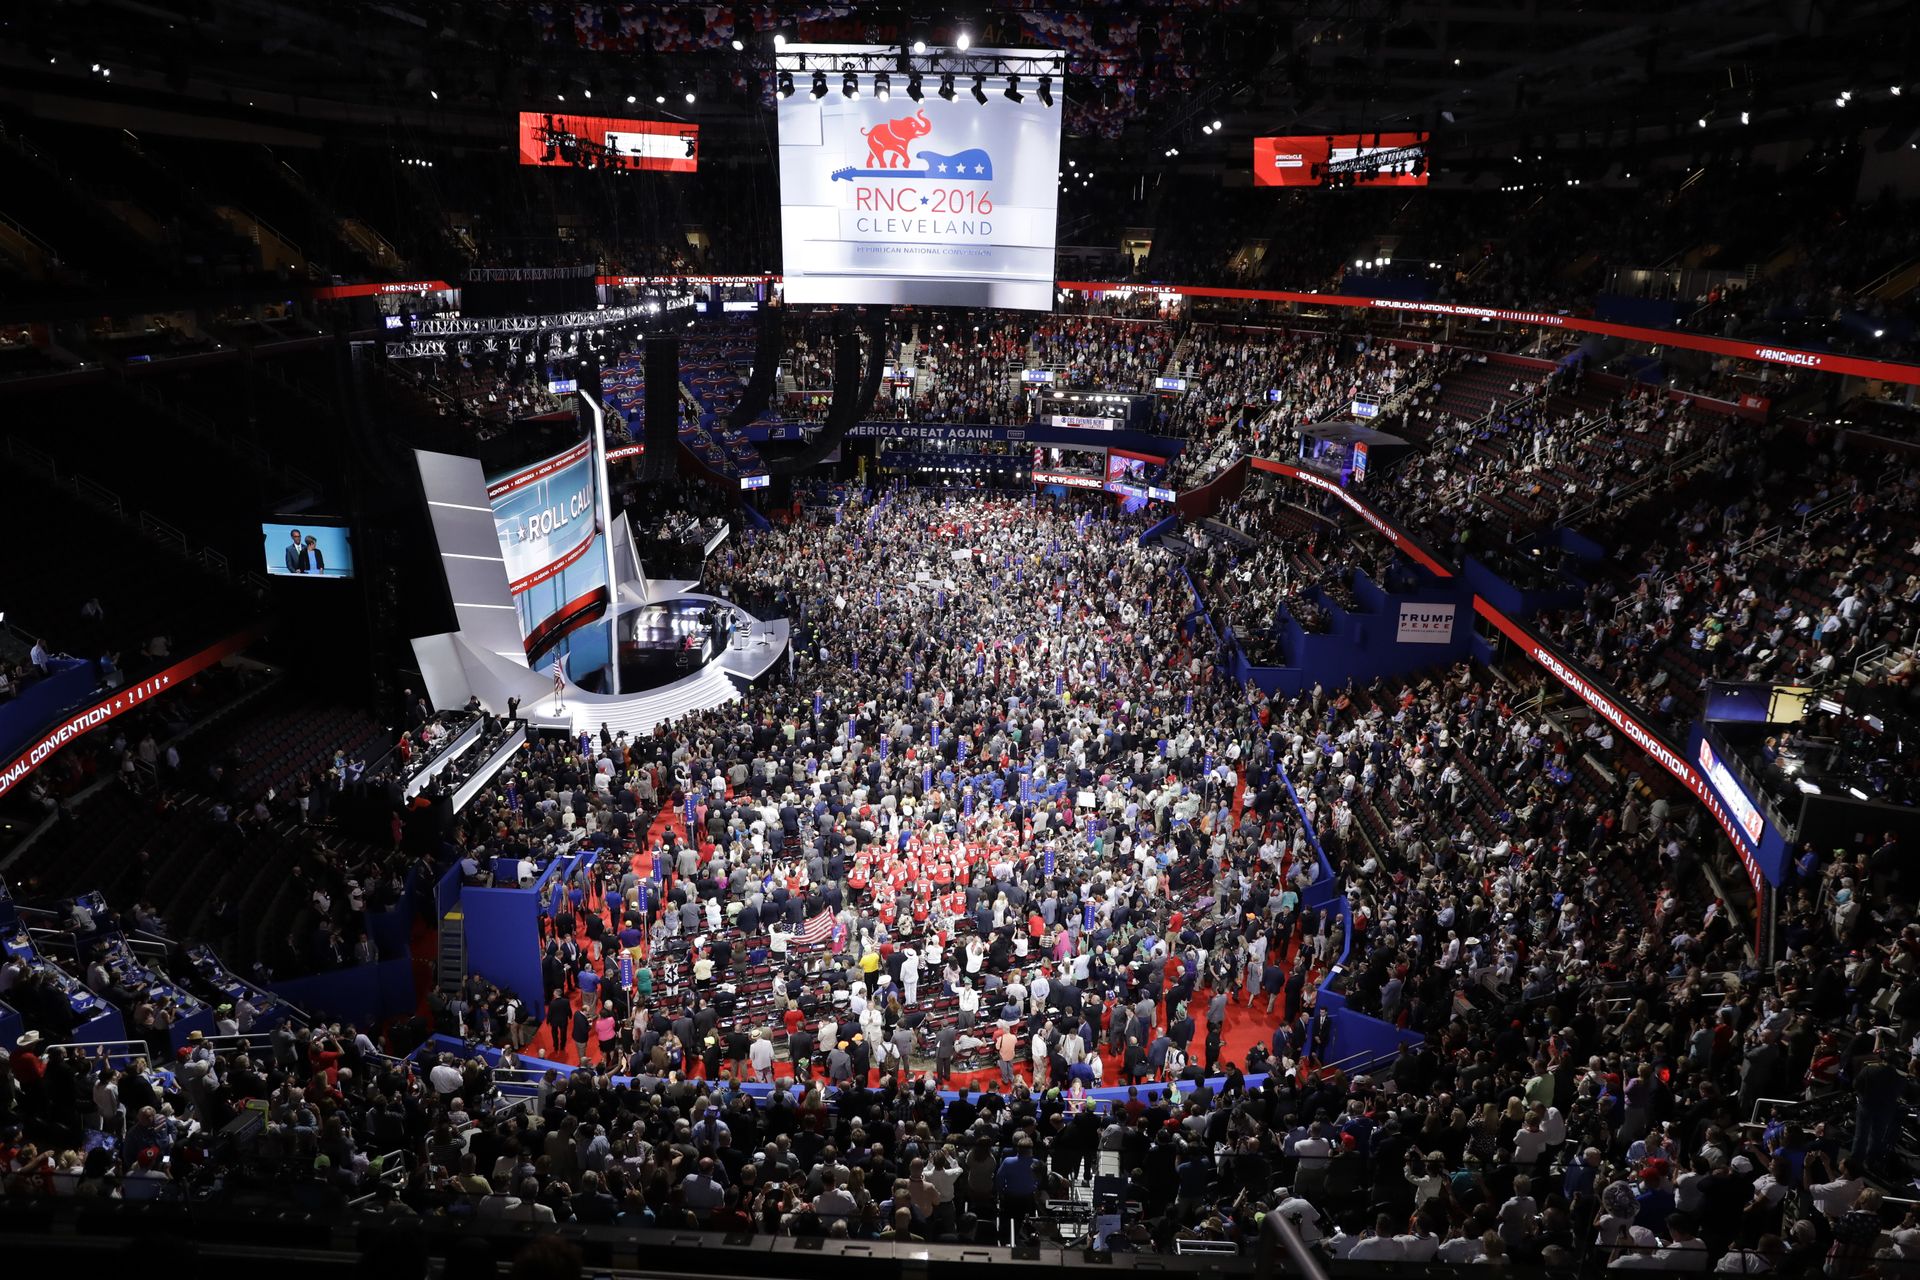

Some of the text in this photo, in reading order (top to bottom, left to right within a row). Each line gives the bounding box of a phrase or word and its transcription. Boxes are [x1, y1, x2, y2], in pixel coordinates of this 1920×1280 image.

[856, 187, 993, 215] RNC 2016
[856, 217, 993, 236] CLEVELAND
[903, 247, 941, 256] NATIONAL
[1375, 300, 1418, 310] REPUBLICAN
[1419, 303, 1454, 313] NATIONAL
[1455, 306, 1497, 317] CONVENTION
[844, 426, 993, 439] MERICA GREAT AGAIN!
[1034, 474, 1102, 488] NBC NEWS MSNBC
[489, 484, 510, 498] MONTANA
[528, 484, 591, 541] ROLL CALL
[1400, 613, 1453, 622] TRUMP
[1401, 622, 1450, 630] PENCE
[30, 703, 112, 765] CONVENTION
[128, 678, 160, 704] 2016
[1537, 649, 1584, 693] REPUBLICAN
[1583, 687, 1624, 728] NATIONAL
[1624, 721, 1689, 780] CONVENTION
[1697, 780, 1741, 846] CLEVELAND
